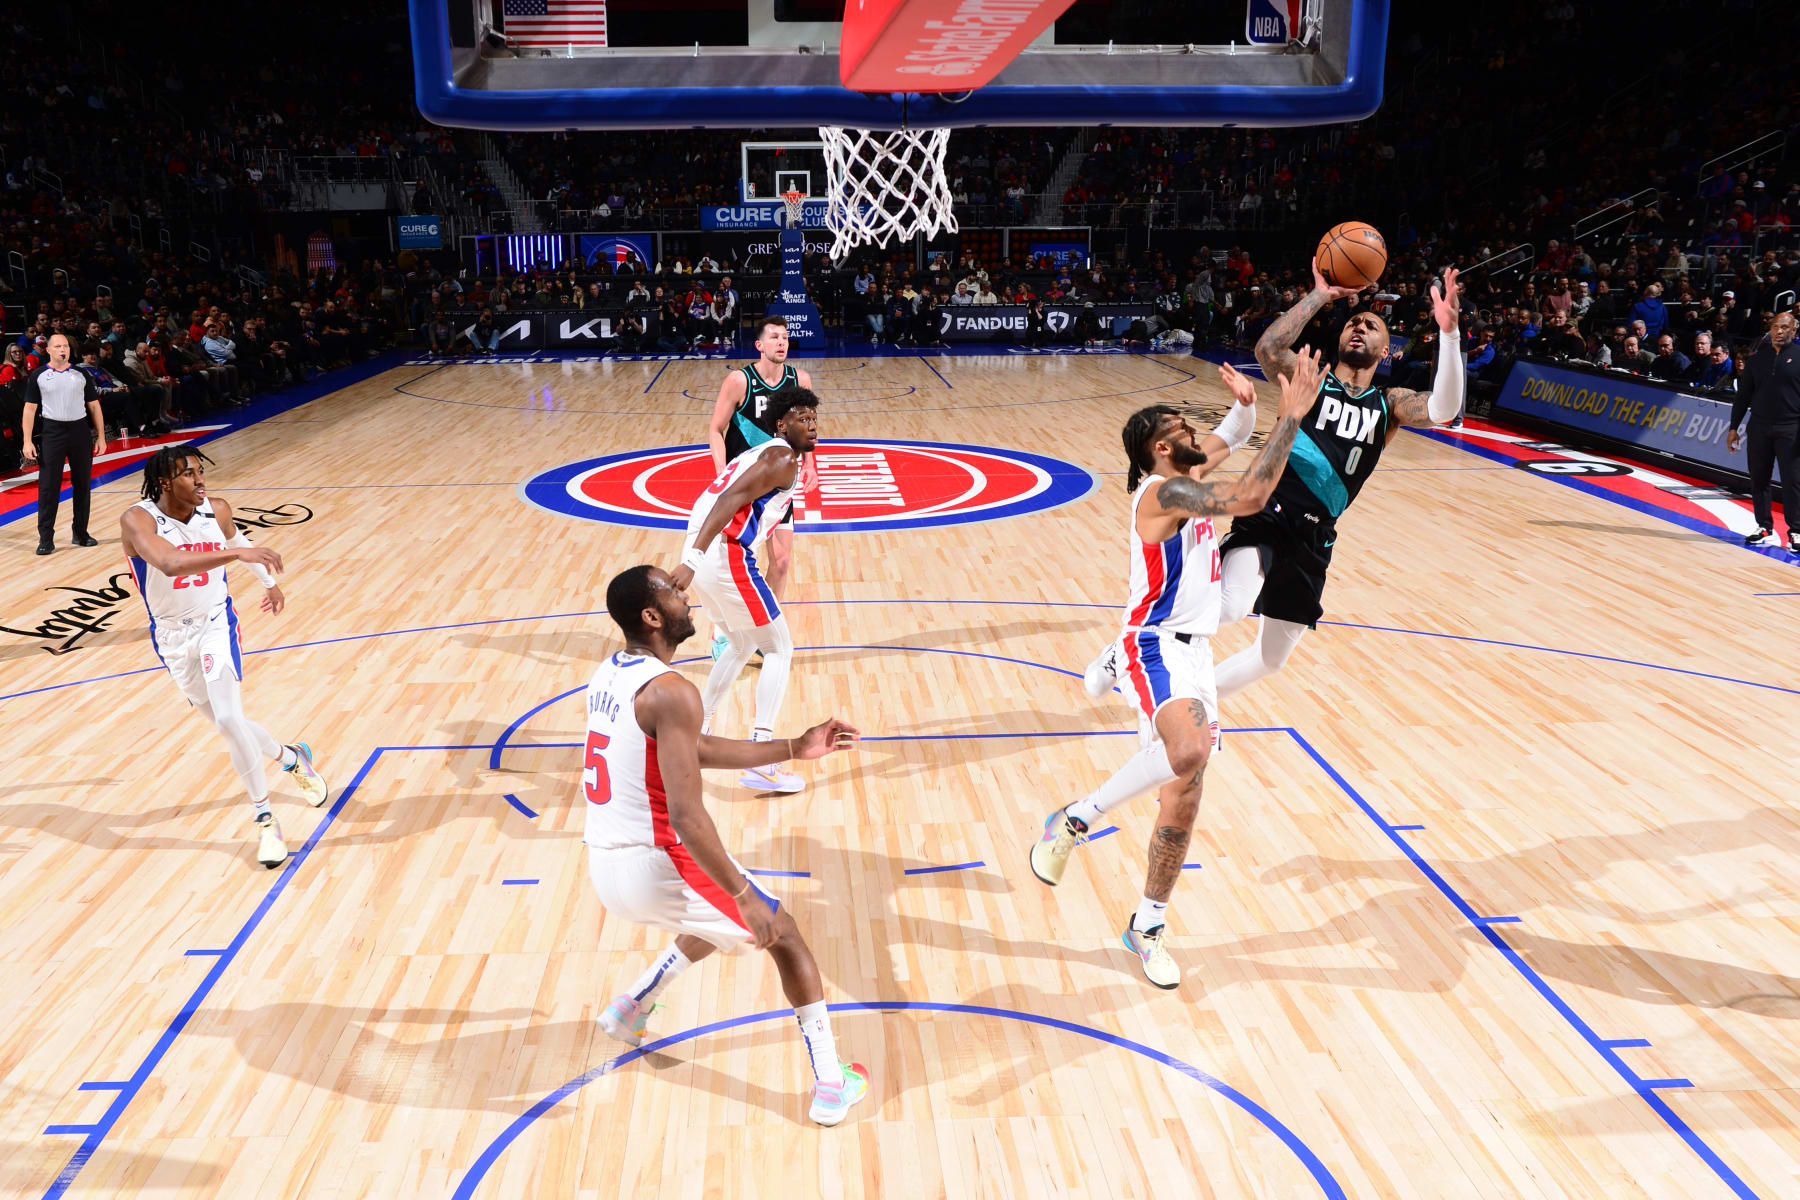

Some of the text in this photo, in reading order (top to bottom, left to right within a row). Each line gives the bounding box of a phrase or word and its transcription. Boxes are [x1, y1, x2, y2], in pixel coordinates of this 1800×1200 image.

[1254, 16, 1280, 37] NBA
[400, 224, 428, 233] CURE
[716, 207, 772, 222] CURE
[783, 314, 808, 322] ENRY
[1315, 395, 1381, 444] PDX
[1521, 377, 1608, 415] DOWNLOAD
[1612, 397, 1642, 424] THE
[1640, 406, 1687, 435] APP!
[1684, 413, 1731, 445] BUY
[1345, 446, 1363, 475] 0
[815, 452, 905, 506] DETROIT
[590, 690, 620, 723] BURKS
[584, 730, 612, 805] 5
